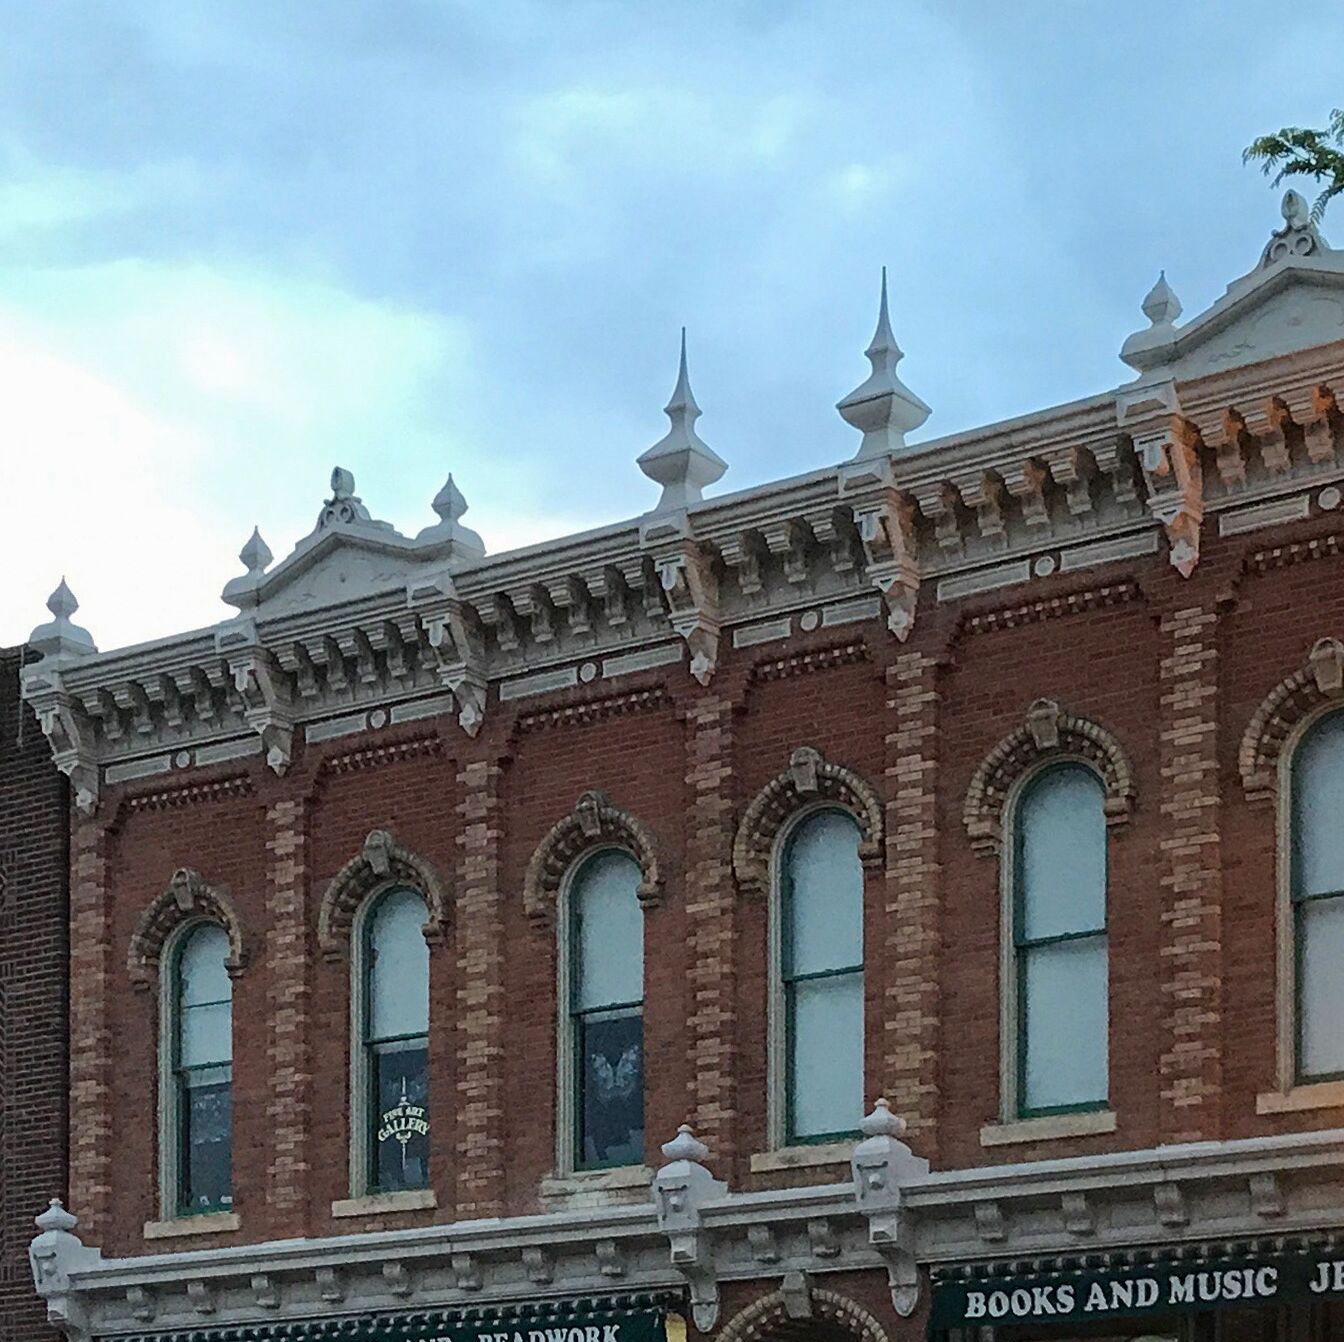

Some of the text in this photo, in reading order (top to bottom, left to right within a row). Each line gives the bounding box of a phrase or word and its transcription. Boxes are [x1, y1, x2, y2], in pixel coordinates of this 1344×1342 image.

[383, 1106, 425, 1123] FINE ART
[378, 1117, 431, 1142] GALLERY
[964, 1284, 1076, 1321] BOOKS
[1083, 1277, 1161, 1313] AND
[1168, 1266, 1280, 1305] MUSIC
